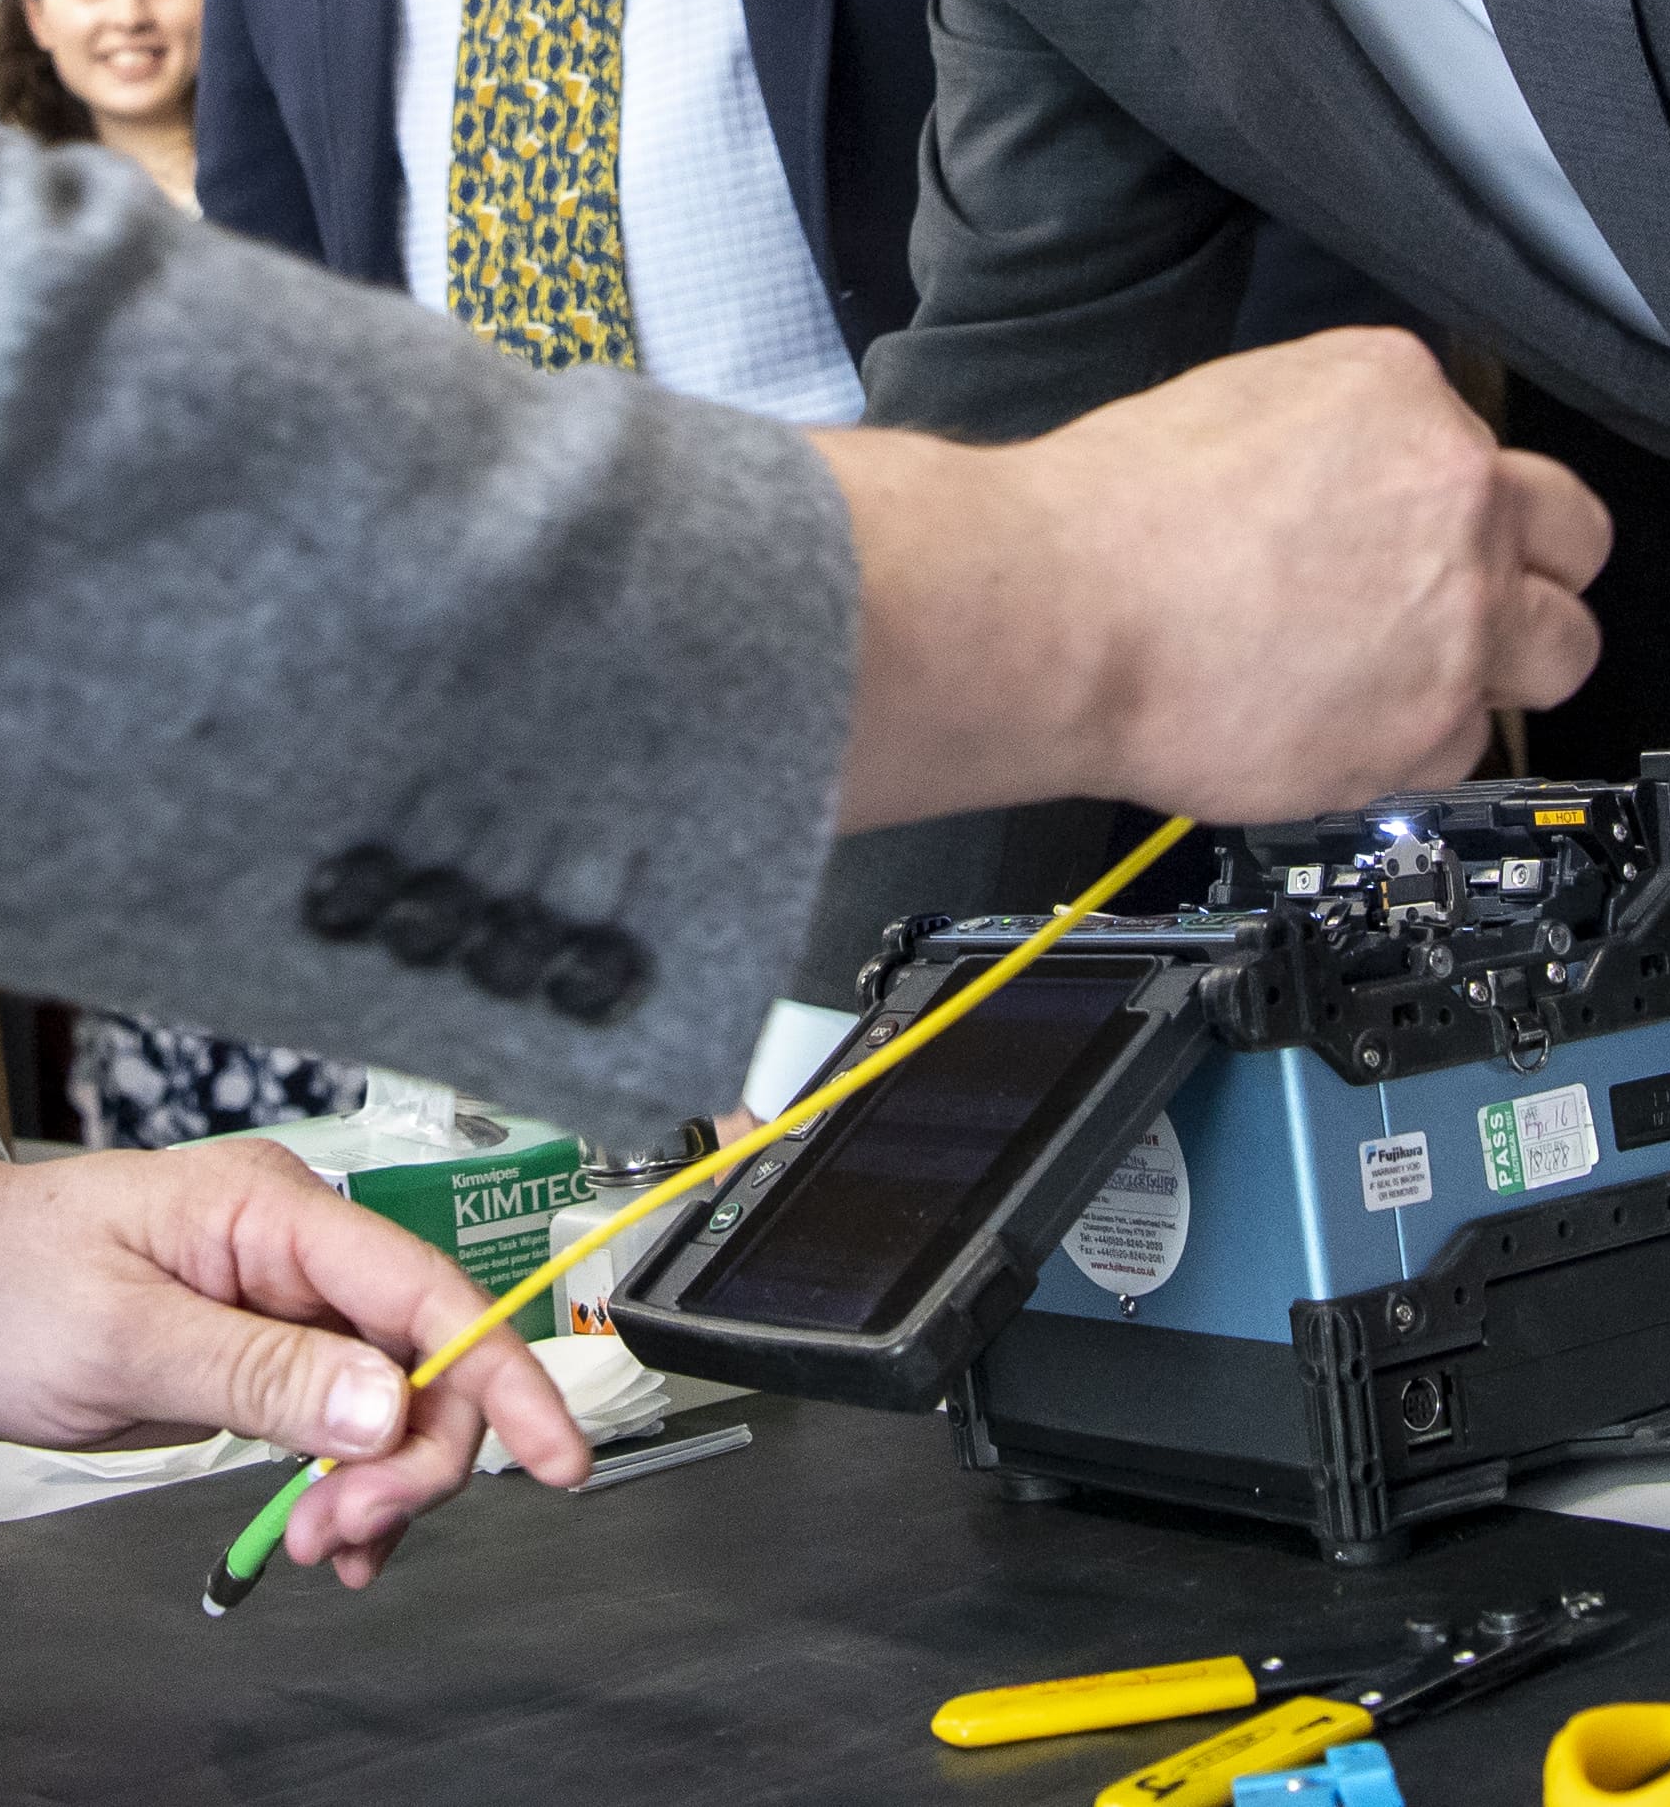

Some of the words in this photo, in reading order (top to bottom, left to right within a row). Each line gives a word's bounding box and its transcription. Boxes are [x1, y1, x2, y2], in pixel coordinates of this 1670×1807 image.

[1555, 811, 1577, 824] HOT
[1505, 1111, 1515, 1131] TEST
[1378, 1146, 1423, 1162] Fujikura
[1490, 1113, 1513, 1187] PASS
[1508, 1132, 1522, 1183] ELECTRICAL
[1371, 1165, 1405, 1178] WARRANTY
[1405, 1161, 1421, 1172] VOID
[452, 1167, 519, 1190] Kimwipes
[1376, 1179, 1391, 1189] SEAL
[1400, 1173, 1426, 1184] BROKEN
[453, 1170, 597, 1226] KIMTEC
[1389, 1186, 1419, 1198] REMOVED
[1080, 1234, 1092, 1243] Tel:
[458, 1245, 497, 1261] Delicate
[497, 1239, 517, 1252] Task
[1081, 1246, 1095, 1256] Fax:
